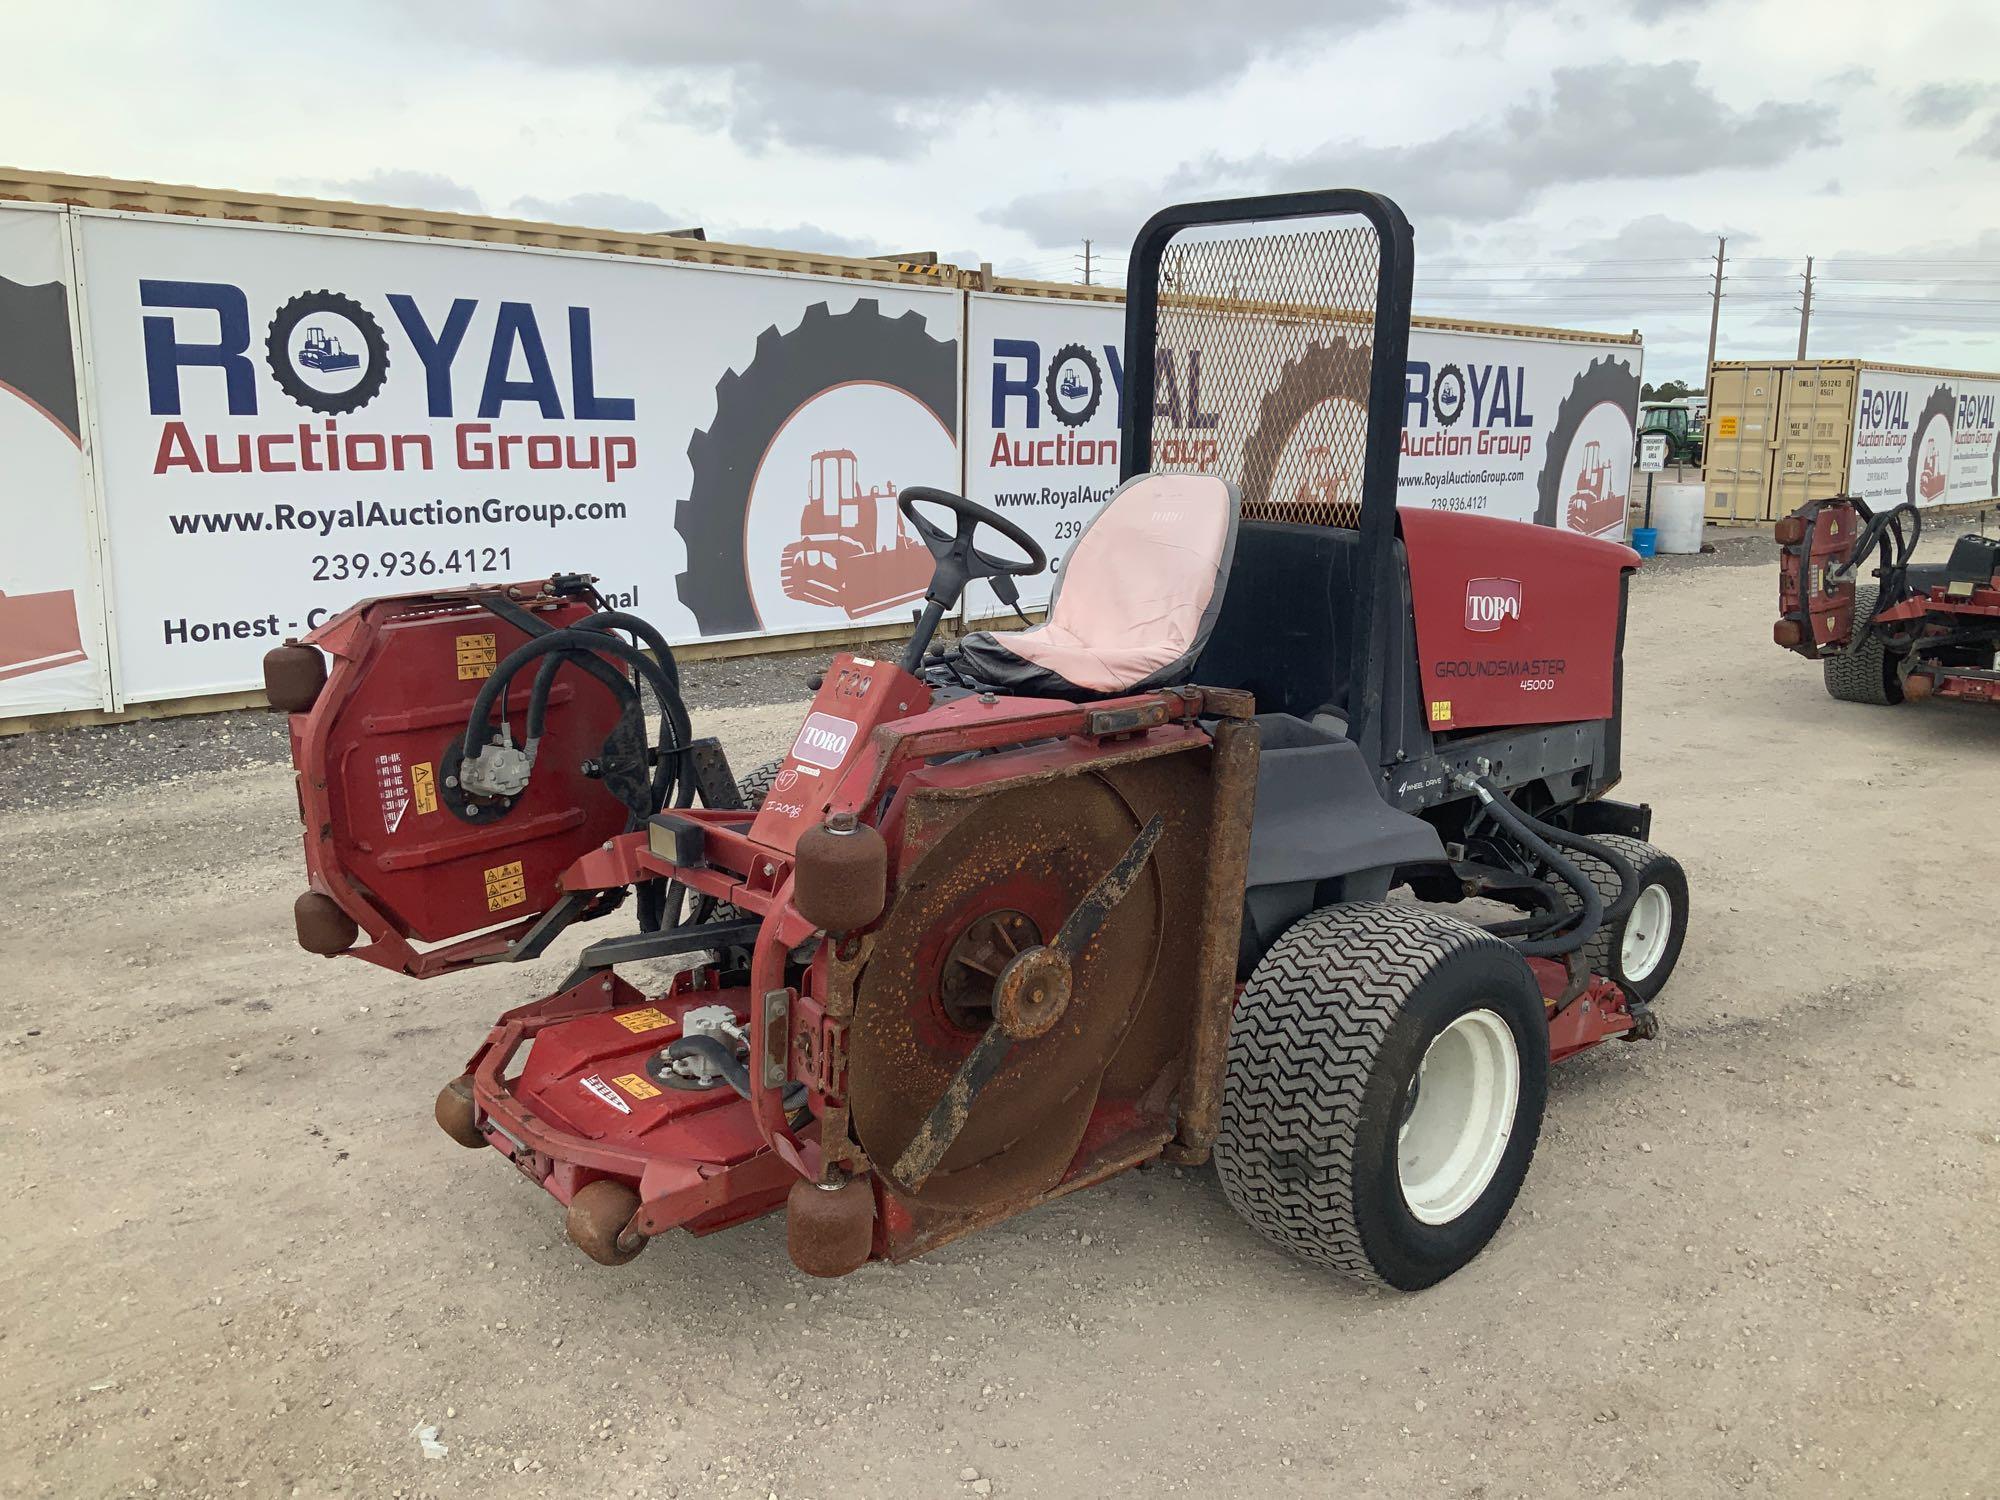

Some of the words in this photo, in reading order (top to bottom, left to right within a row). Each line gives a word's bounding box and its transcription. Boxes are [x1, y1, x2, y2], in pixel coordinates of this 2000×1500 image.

[139, 279, 636, 420] ROYAL
[1402, 361, 1533, 428] ROYAL
[1860, 389, 1909, 430] ROYAL
[1957, 394, 1995, 430] ROYAL
[153, 419, 434, 475] Auction
[456, 423, 637, 482] Group
[990, 431, 1117, 467] Auction
[1400, 429, 1472, 457] Auction
[1478, 430, 1531, 461] Group
[1857, 430, 1884, 447] Auction
[1885, 431, 1906, 449] Group
[1955, 430, 1974, 445] Auction
[1975, 431, 1992, 447] Group
[1398, 470, 1524, 490] www.RoyalAuctionGroup.com
[169, 499, 627, 537] www.RoyalAuctionGroup.com
[1432, 496, 1487, 511] 239.936.4121
[312, 548, 512, 581] 239.936.4121
[1470, 596, 1517, 621] TORO
[164, 613, 278, 645] Honest
[1435, 660, 1567, 678] GROUNDSMASTER
[803, 726, 847, 754] TORO
[779, 771, 795, 785] 47
[1407, 782, 1424, 791] WHEEL
[1426, 777, 1442, 787] DRIVE
